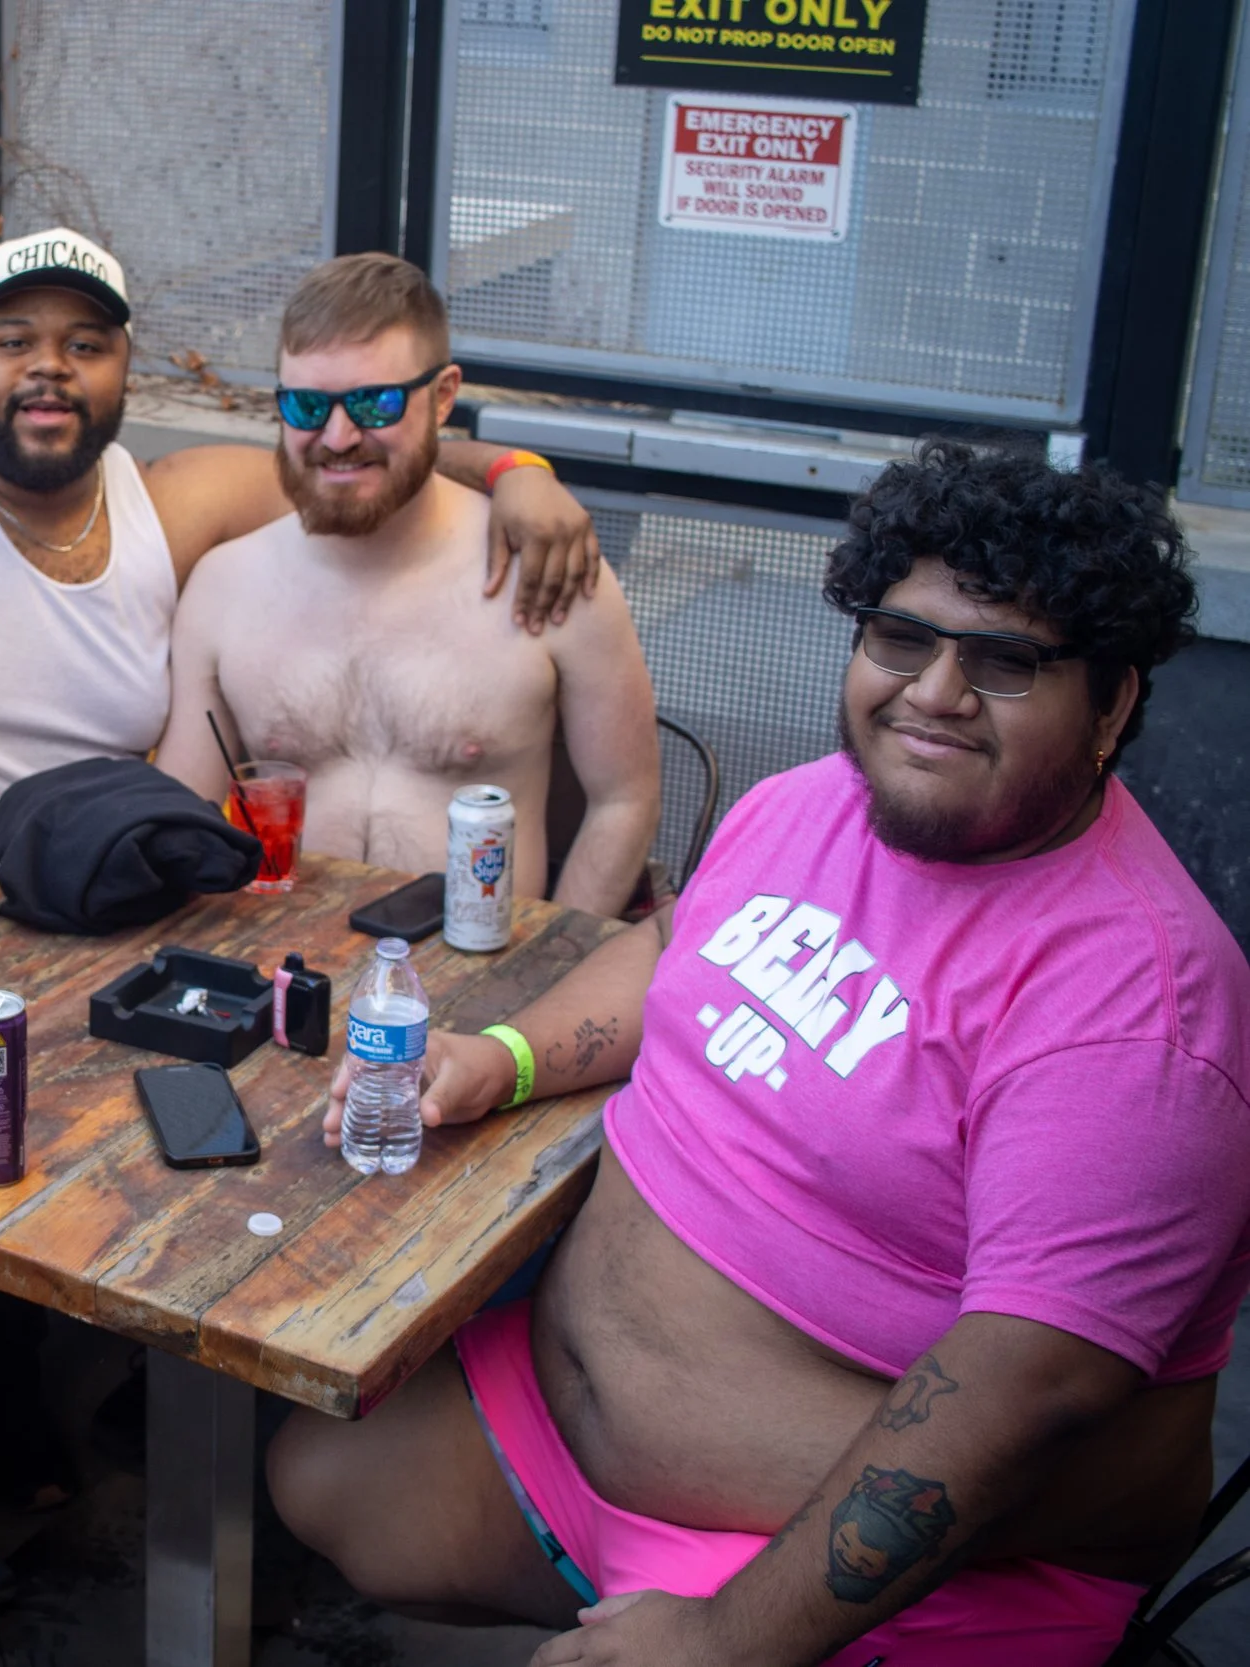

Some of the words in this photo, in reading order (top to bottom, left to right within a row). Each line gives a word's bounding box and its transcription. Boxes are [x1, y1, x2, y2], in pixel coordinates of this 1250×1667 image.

[649, 0, 749, 22] EXIT
[764, 0, 893, 30] ONLY
[641, 24, 672, 42] DO
[674, 26, 718, 45] NOT
[718, 29, 774, 48] PROP
[776, 32, 836, 52] DOOR
[838, 36, 896, 56] OPEN
[684, 109, 836, 140] EMERGENCY
[696, 132, 749, 156] EXIT
[753, 138, 820, 161] ONLY
[685, 160, 763, 181] SECURITY
[766, 167, 825, 186] ALARM
[703, 180, 741, 198] WILL
[745, 184, 804, 202] SOUND
[677, 196, 691, 210] IF
[695, 198, 740, 214] DOOR
[743, 202, 758, 218] IS
[763, 204, 828, 223] OPENED
[8, 240, 108, 284] CHICAGO
[696, 893, 910, 1080] BELLY
[348, 1020, 386, 1046] gara
